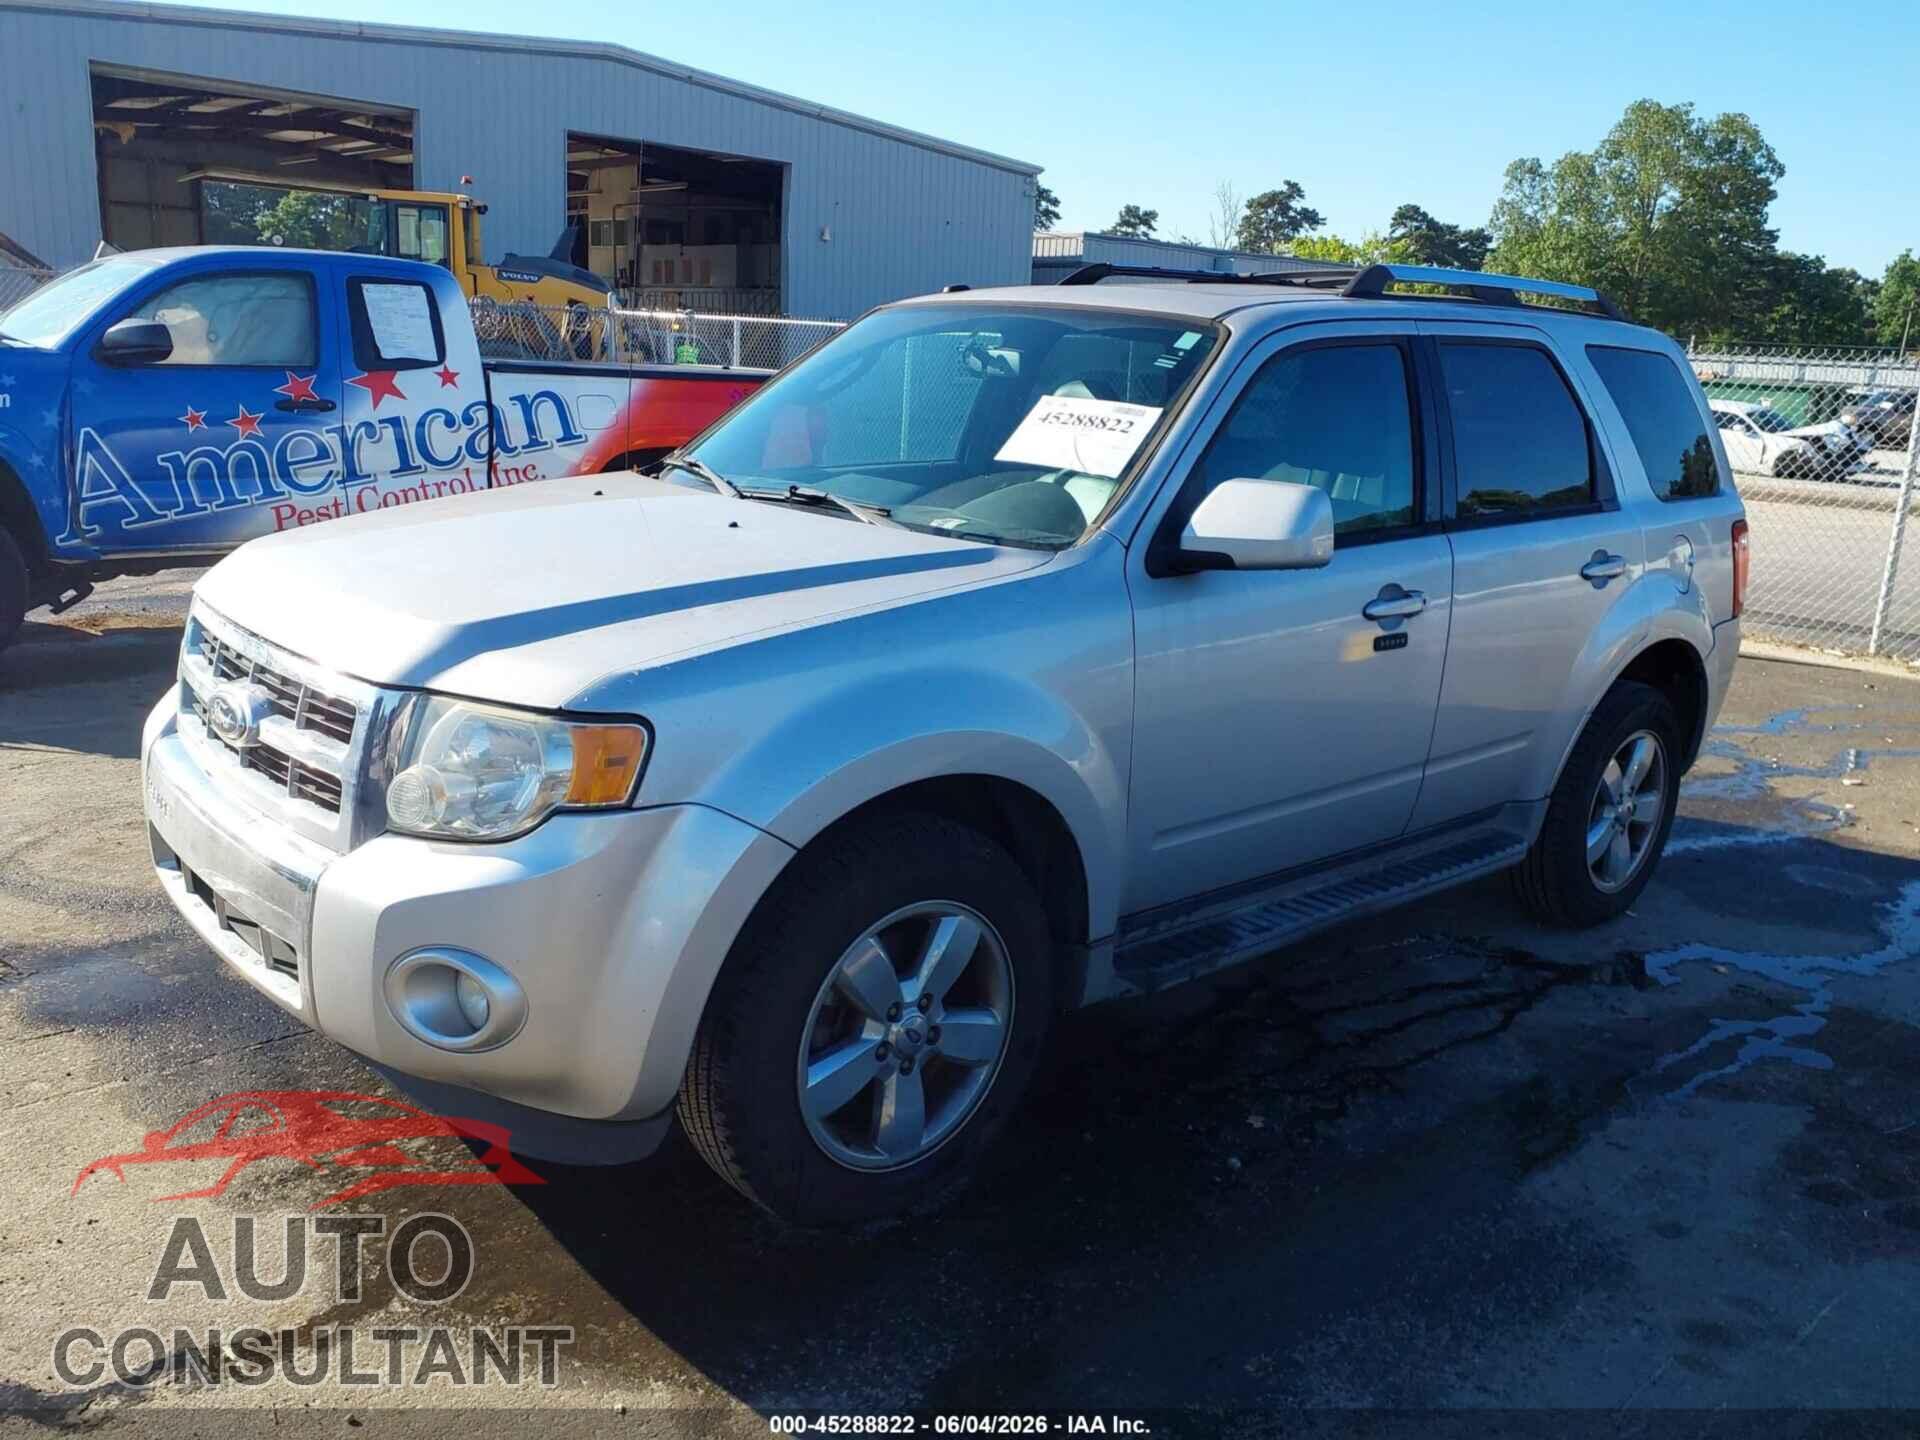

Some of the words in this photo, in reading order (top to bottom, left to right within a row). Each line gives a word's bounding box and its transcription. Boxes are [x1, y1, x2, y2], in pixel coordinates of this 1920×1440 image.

[502, 271, 538, 281] VOLVO
[1038, 411, 1135, 434] 45288822
[56, 388, 588, 547] American
[270, 496, 343, 532] Pest
[491, 462, 546, 487] Inc.
